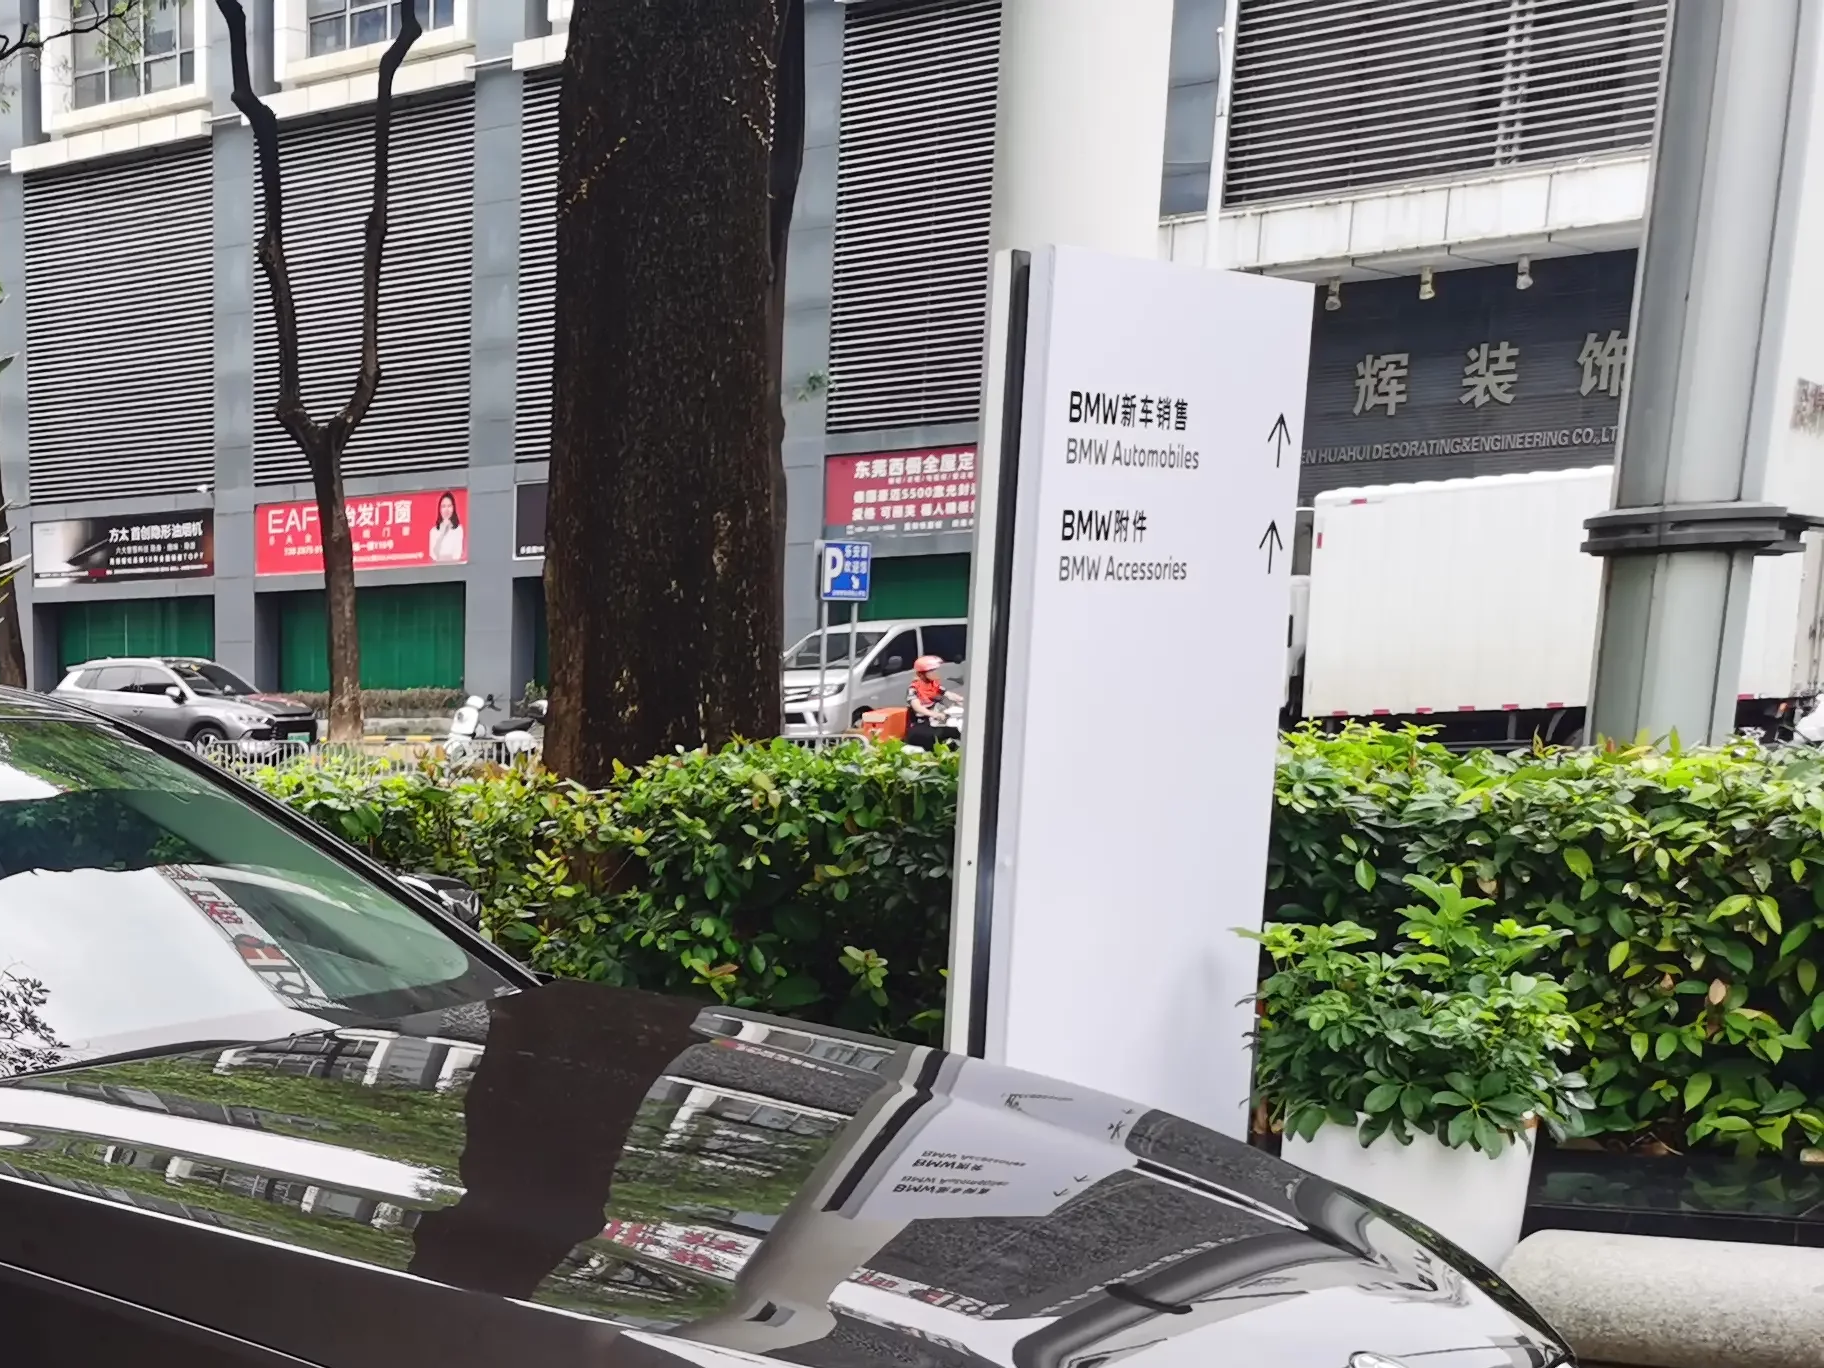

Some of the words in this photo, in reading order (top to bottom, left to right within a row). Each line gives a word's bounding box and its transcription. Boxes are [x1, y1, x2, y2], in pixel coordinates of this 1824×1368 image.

[1069, 390, 1188, 431] BMW新车销售
[1066, 438, 1108, 465] BMW
[1112, 440, 1199, 470] Automobiles
[1320, 445, 1373, 464] HUAHUI
[1061, 509, 1147, 543] BMW附件
[824, 547, 844, 593] P
[1059, 555, 1101, 581] BMW
[1104, 555, 1188, 582] Accessories
